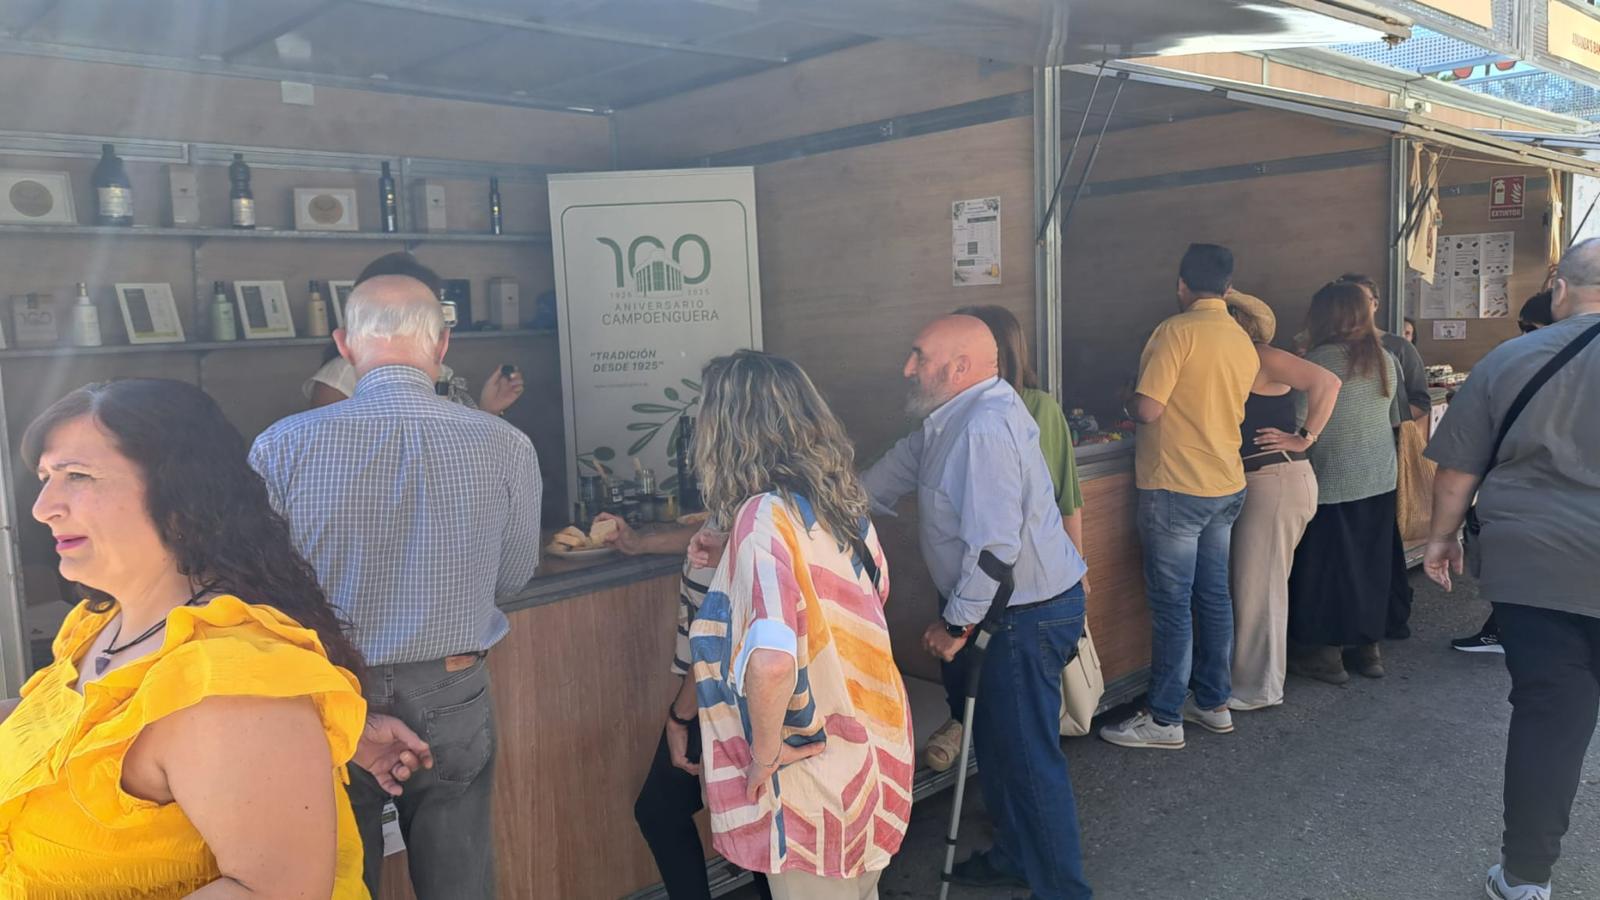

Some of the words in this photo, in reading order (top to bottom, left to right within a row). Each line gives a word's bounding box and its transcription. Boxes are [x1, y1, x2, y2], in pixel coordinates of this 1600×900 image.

[1491, 208, 1521, 217] EXTINTOR
[614, 299, 705, 312] ANIVERSARIO
[601, 309, 720, 326] CAMPOENGUERA
[592, 362, 629, 373] DESDE
